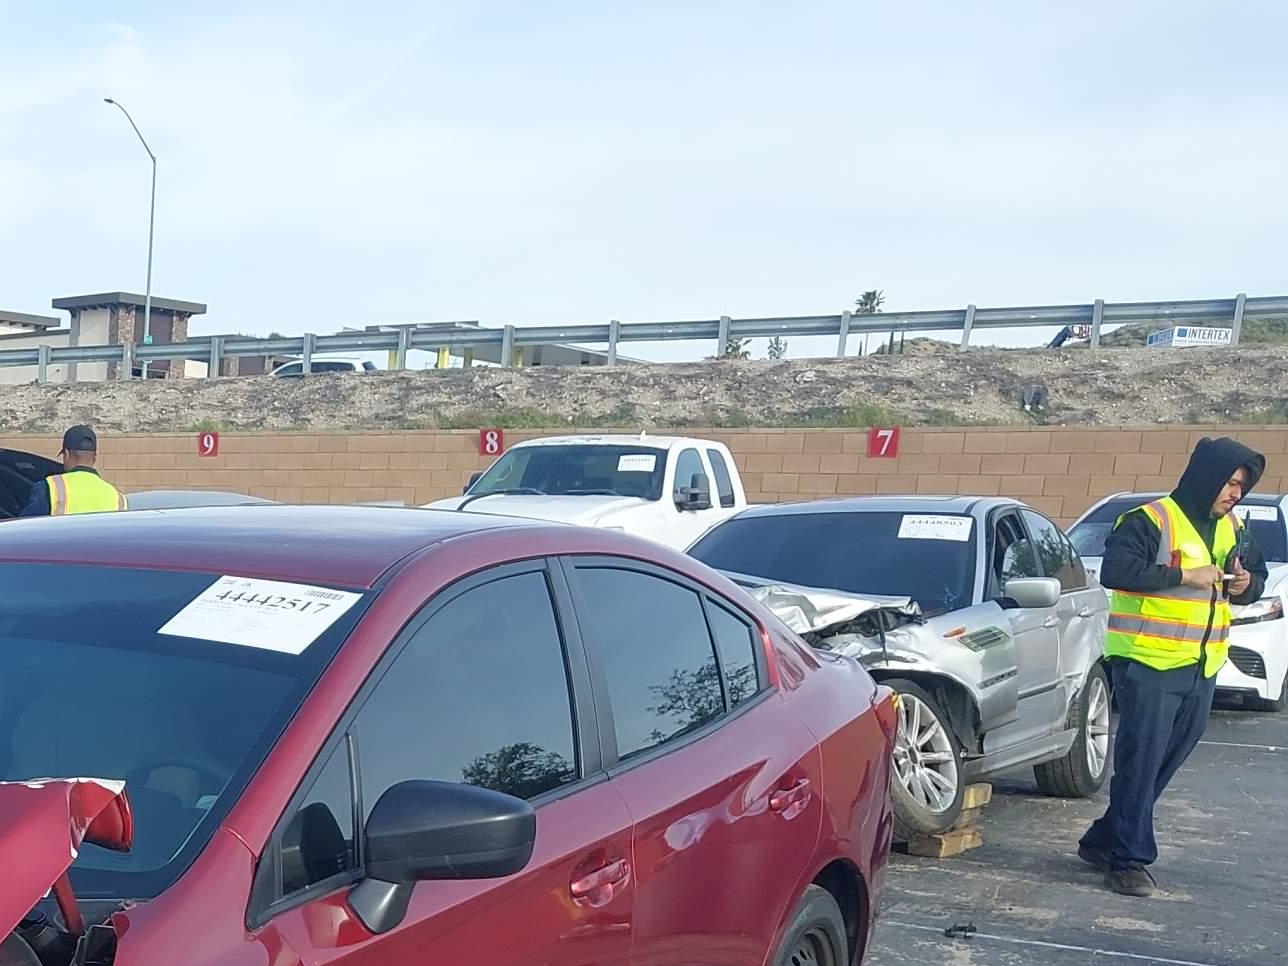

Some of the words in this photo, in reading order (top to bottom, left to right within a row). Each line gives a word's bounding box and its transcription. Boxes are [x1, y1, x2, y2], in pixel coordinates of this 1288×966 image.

[1187, 328, 1231, 340] INTERTEX
[203, 434, 214, 455] 9
[485, 431, 499, 453] 8
[876, 430, 894, 455] 7
[215, 590, 331, 615] 44442517
